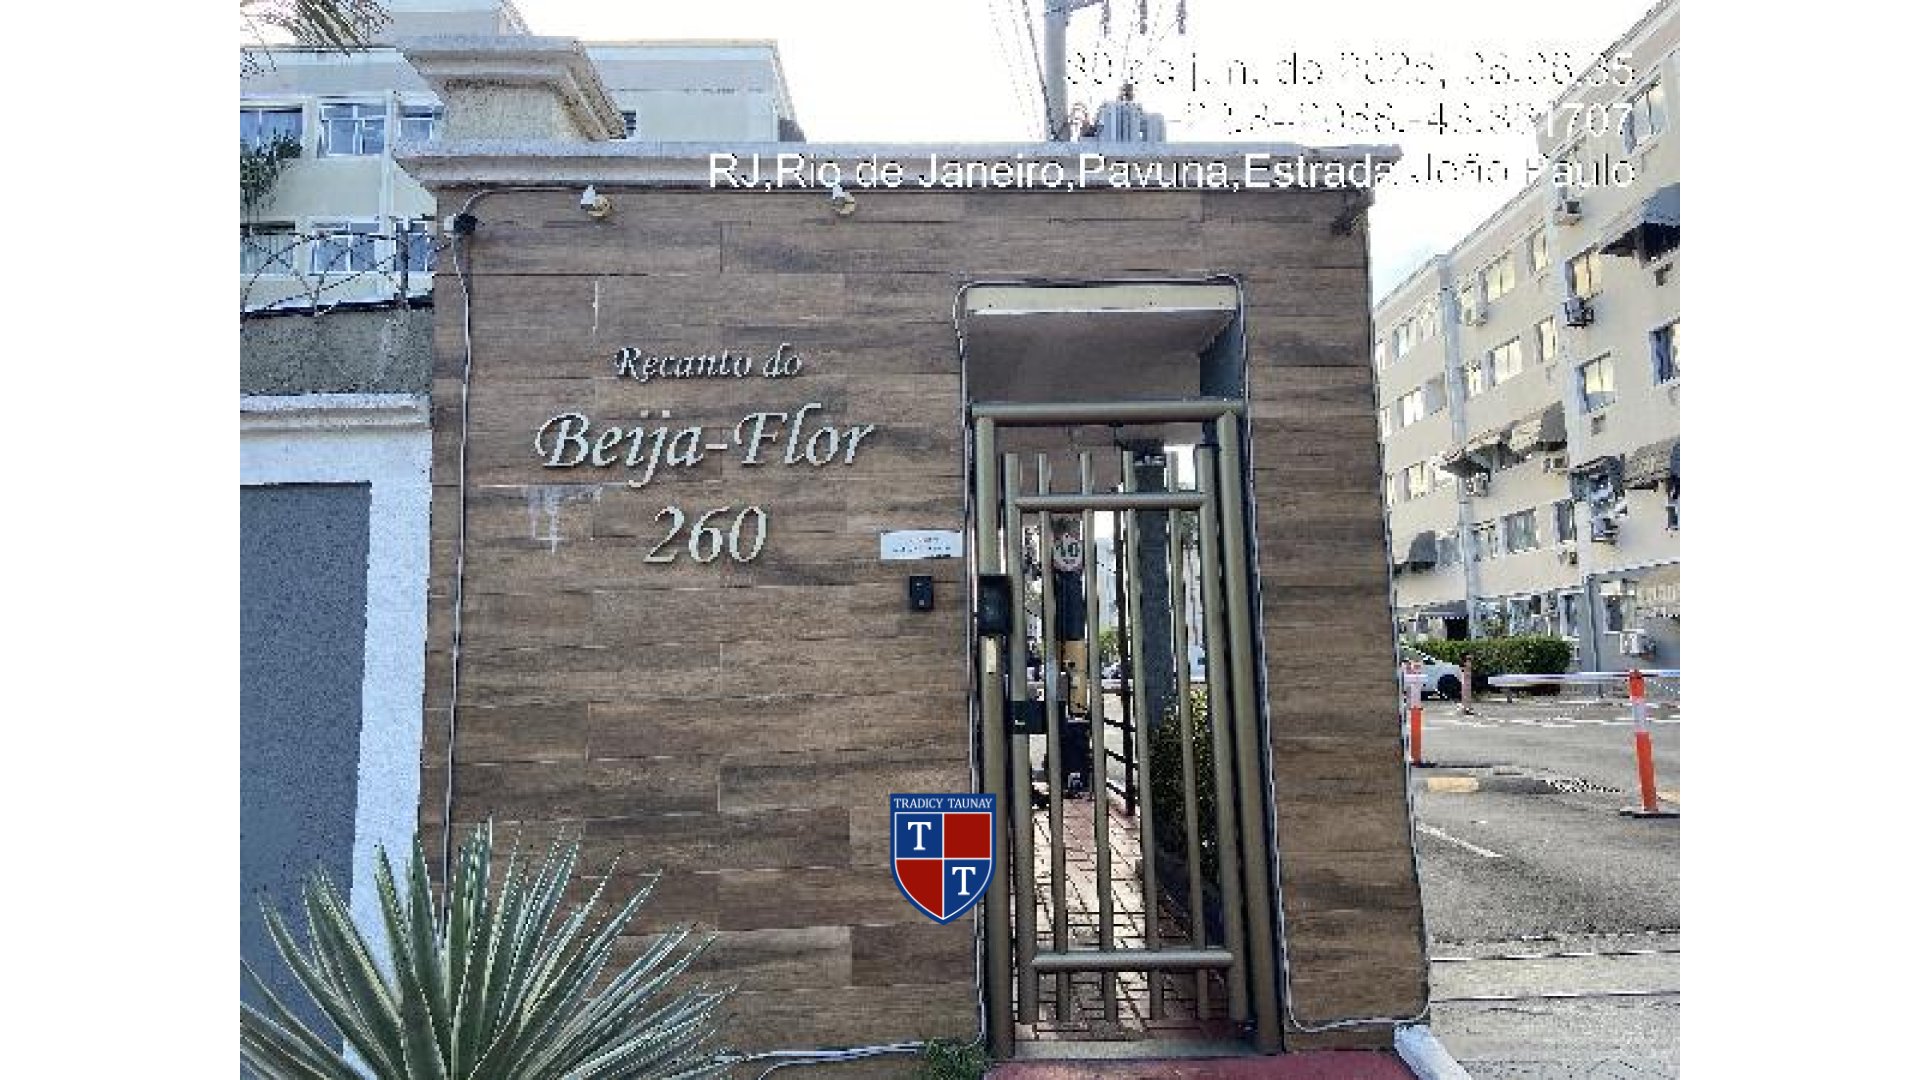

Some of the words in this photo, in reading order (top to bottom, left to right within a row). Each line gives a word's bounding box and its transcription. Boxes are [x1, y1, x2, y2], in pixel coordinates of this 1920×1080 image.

[614, 346, 752, 383] Recanto
[762, 342, 804, 378] do
[533, 402, 875, 488] Beija-Flor
[643, 506, 768, 565] 260
